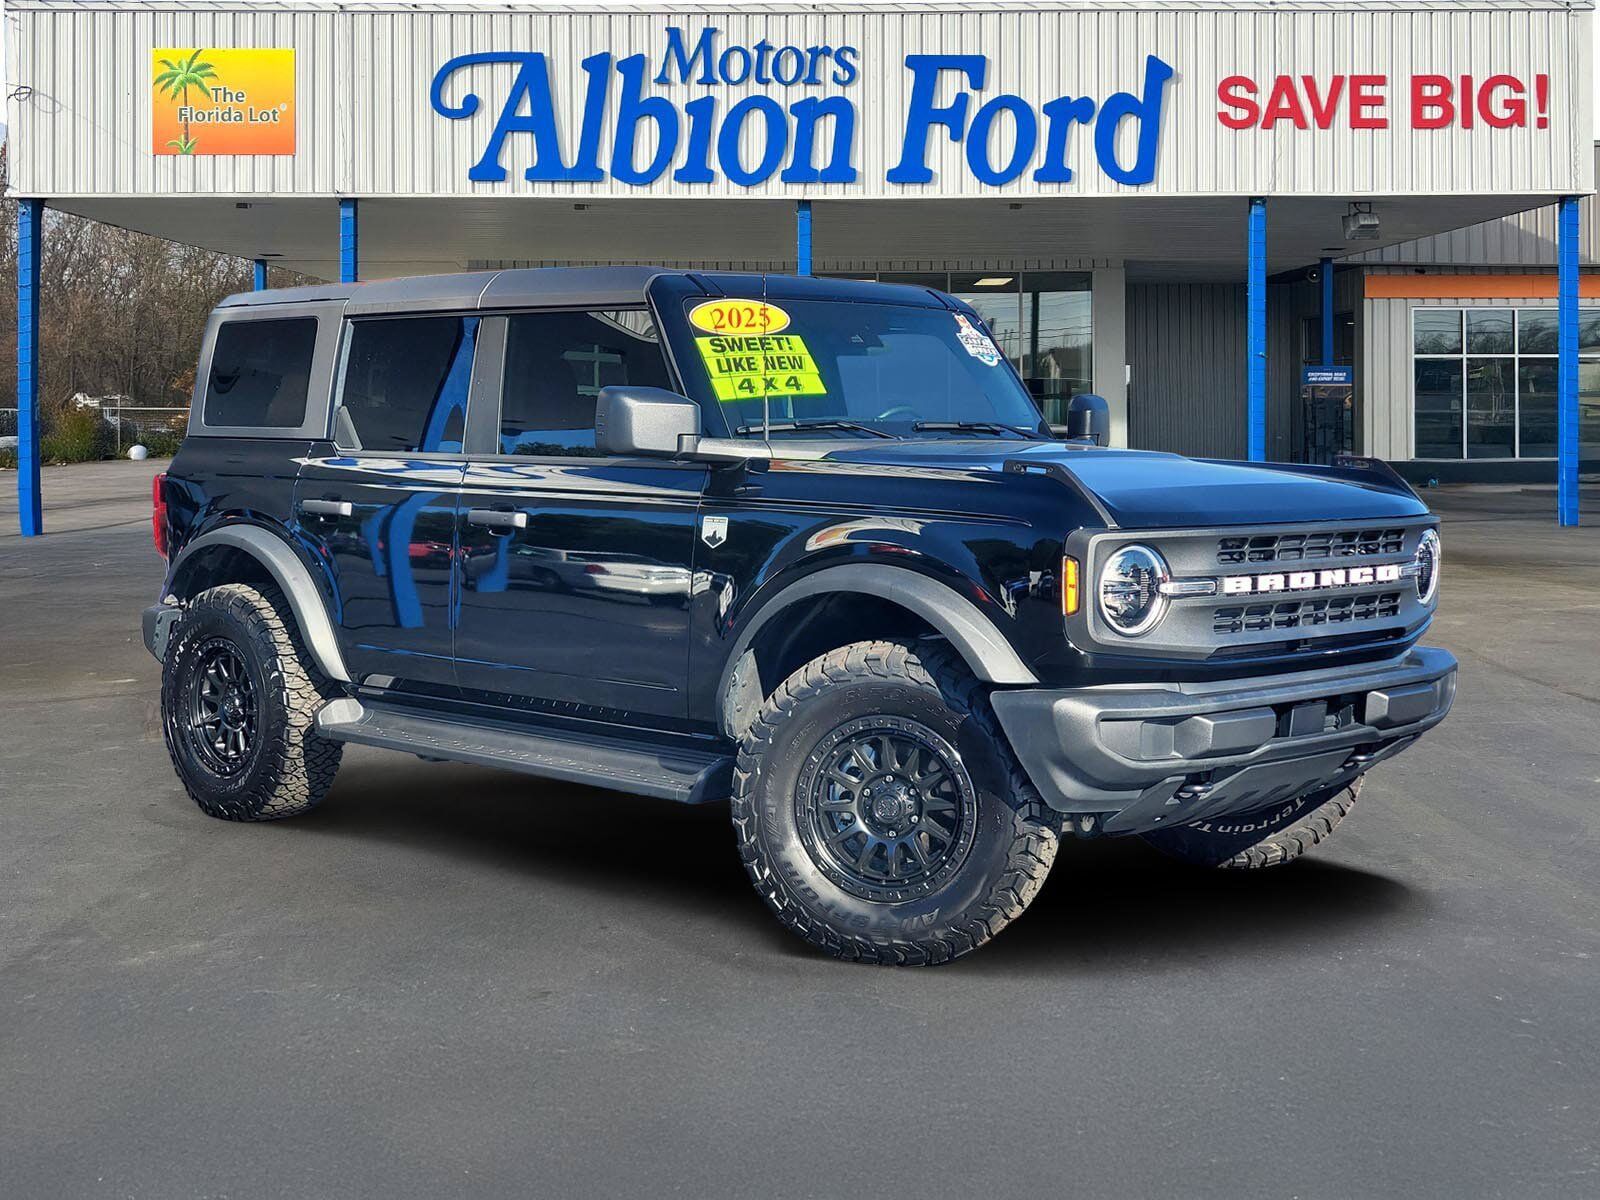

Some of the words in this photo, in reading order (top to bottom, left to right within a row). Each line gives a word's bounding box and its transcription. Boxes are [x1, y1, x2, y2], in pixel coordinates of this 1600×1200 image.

[653, 26, 858, 86] Motors
[211, 86, 246, 103] The
[1217, 74, 1389, 130] SAVE
[1411, 74, 1549, 130] BIG!
[178, 107, 244, 123] Florida
[249, 107, 279, 123] Lot
[429, 51, 858, 187] Albion
[886, 54, 1174, 187] Ford
[711, 306, 771, 330] 2025
[709, 336, 794, 354] SWEET!
[716, 357, 757, 374] LIKE
[764, 355, 804, 371] NEW
[738, 377, 755, 394] 4
[785, 376, 802, 391] 4
[1223, 564, 1399, 594] BRONCO
